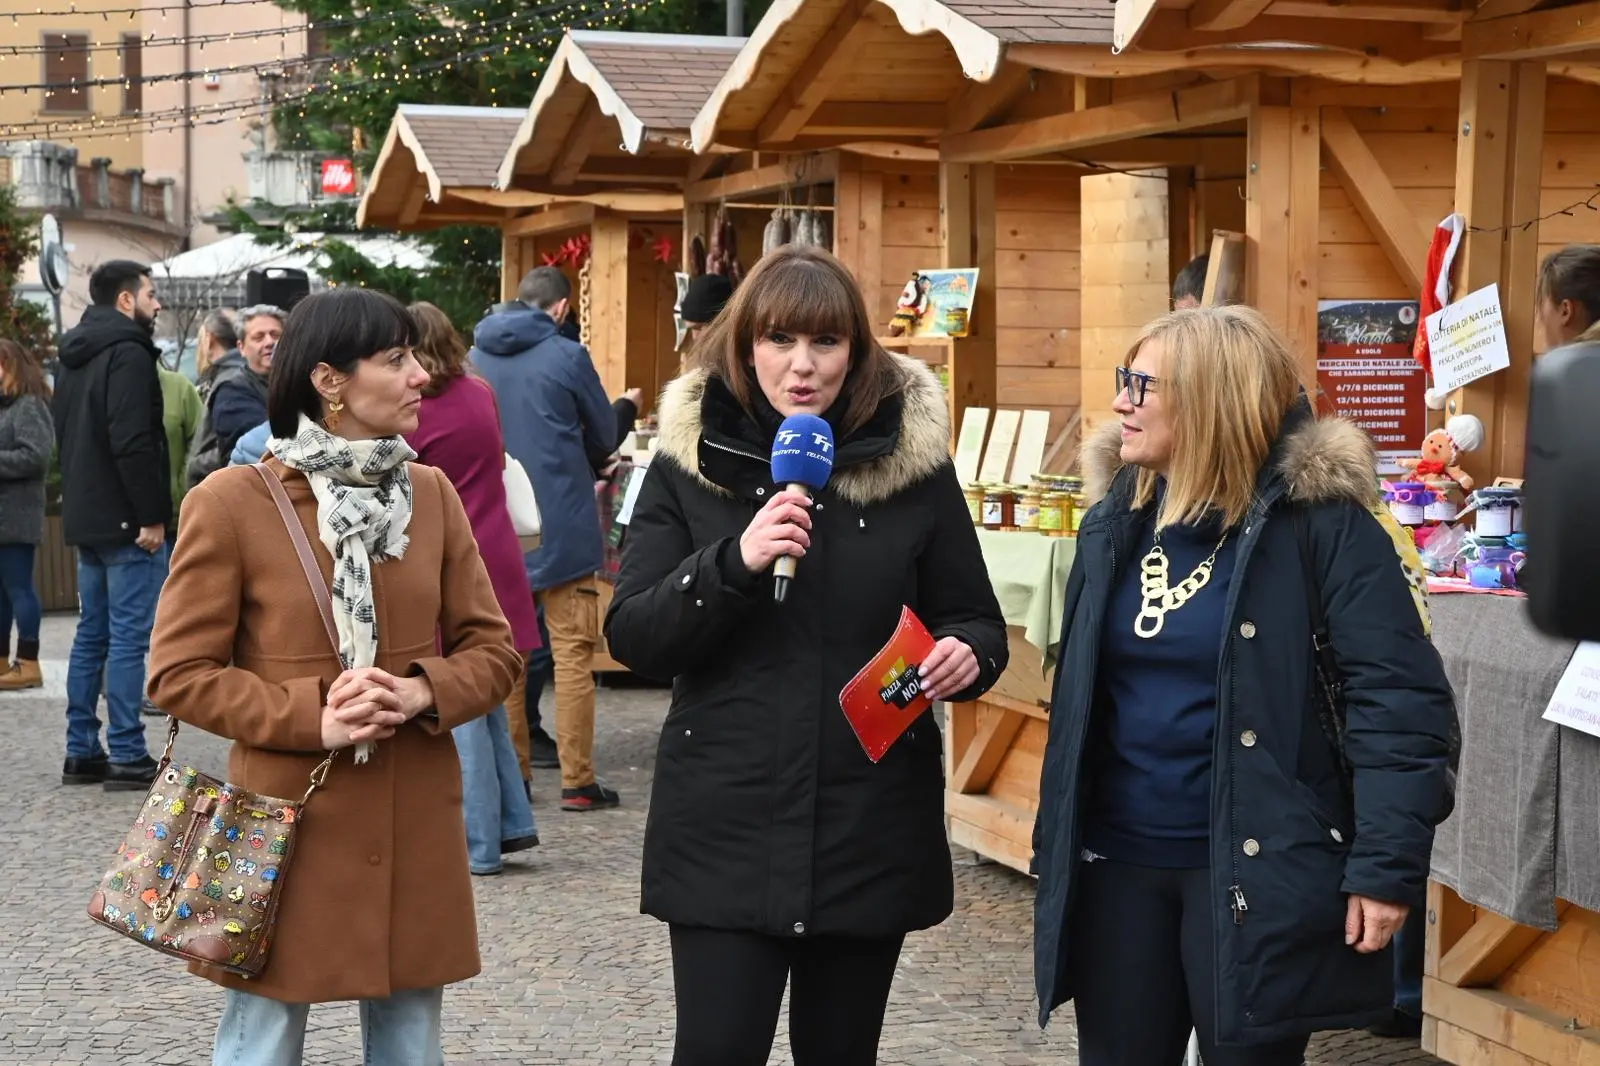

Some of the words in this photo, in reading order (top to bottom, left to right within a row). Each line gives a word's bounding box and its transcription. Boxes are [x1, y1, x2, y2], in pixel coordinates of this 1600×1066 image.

[323, 164, 352, 190] illy
[1469, 305, 1498, 323] NATALE
[1363, 383, 1405, 391] DICEMBRE
[1363, 396, 1405, 404] DICEMBRE
[1364, 408, 1406, 417] DICEMBRE
[881, 679, 902, 701] PIAZZA
